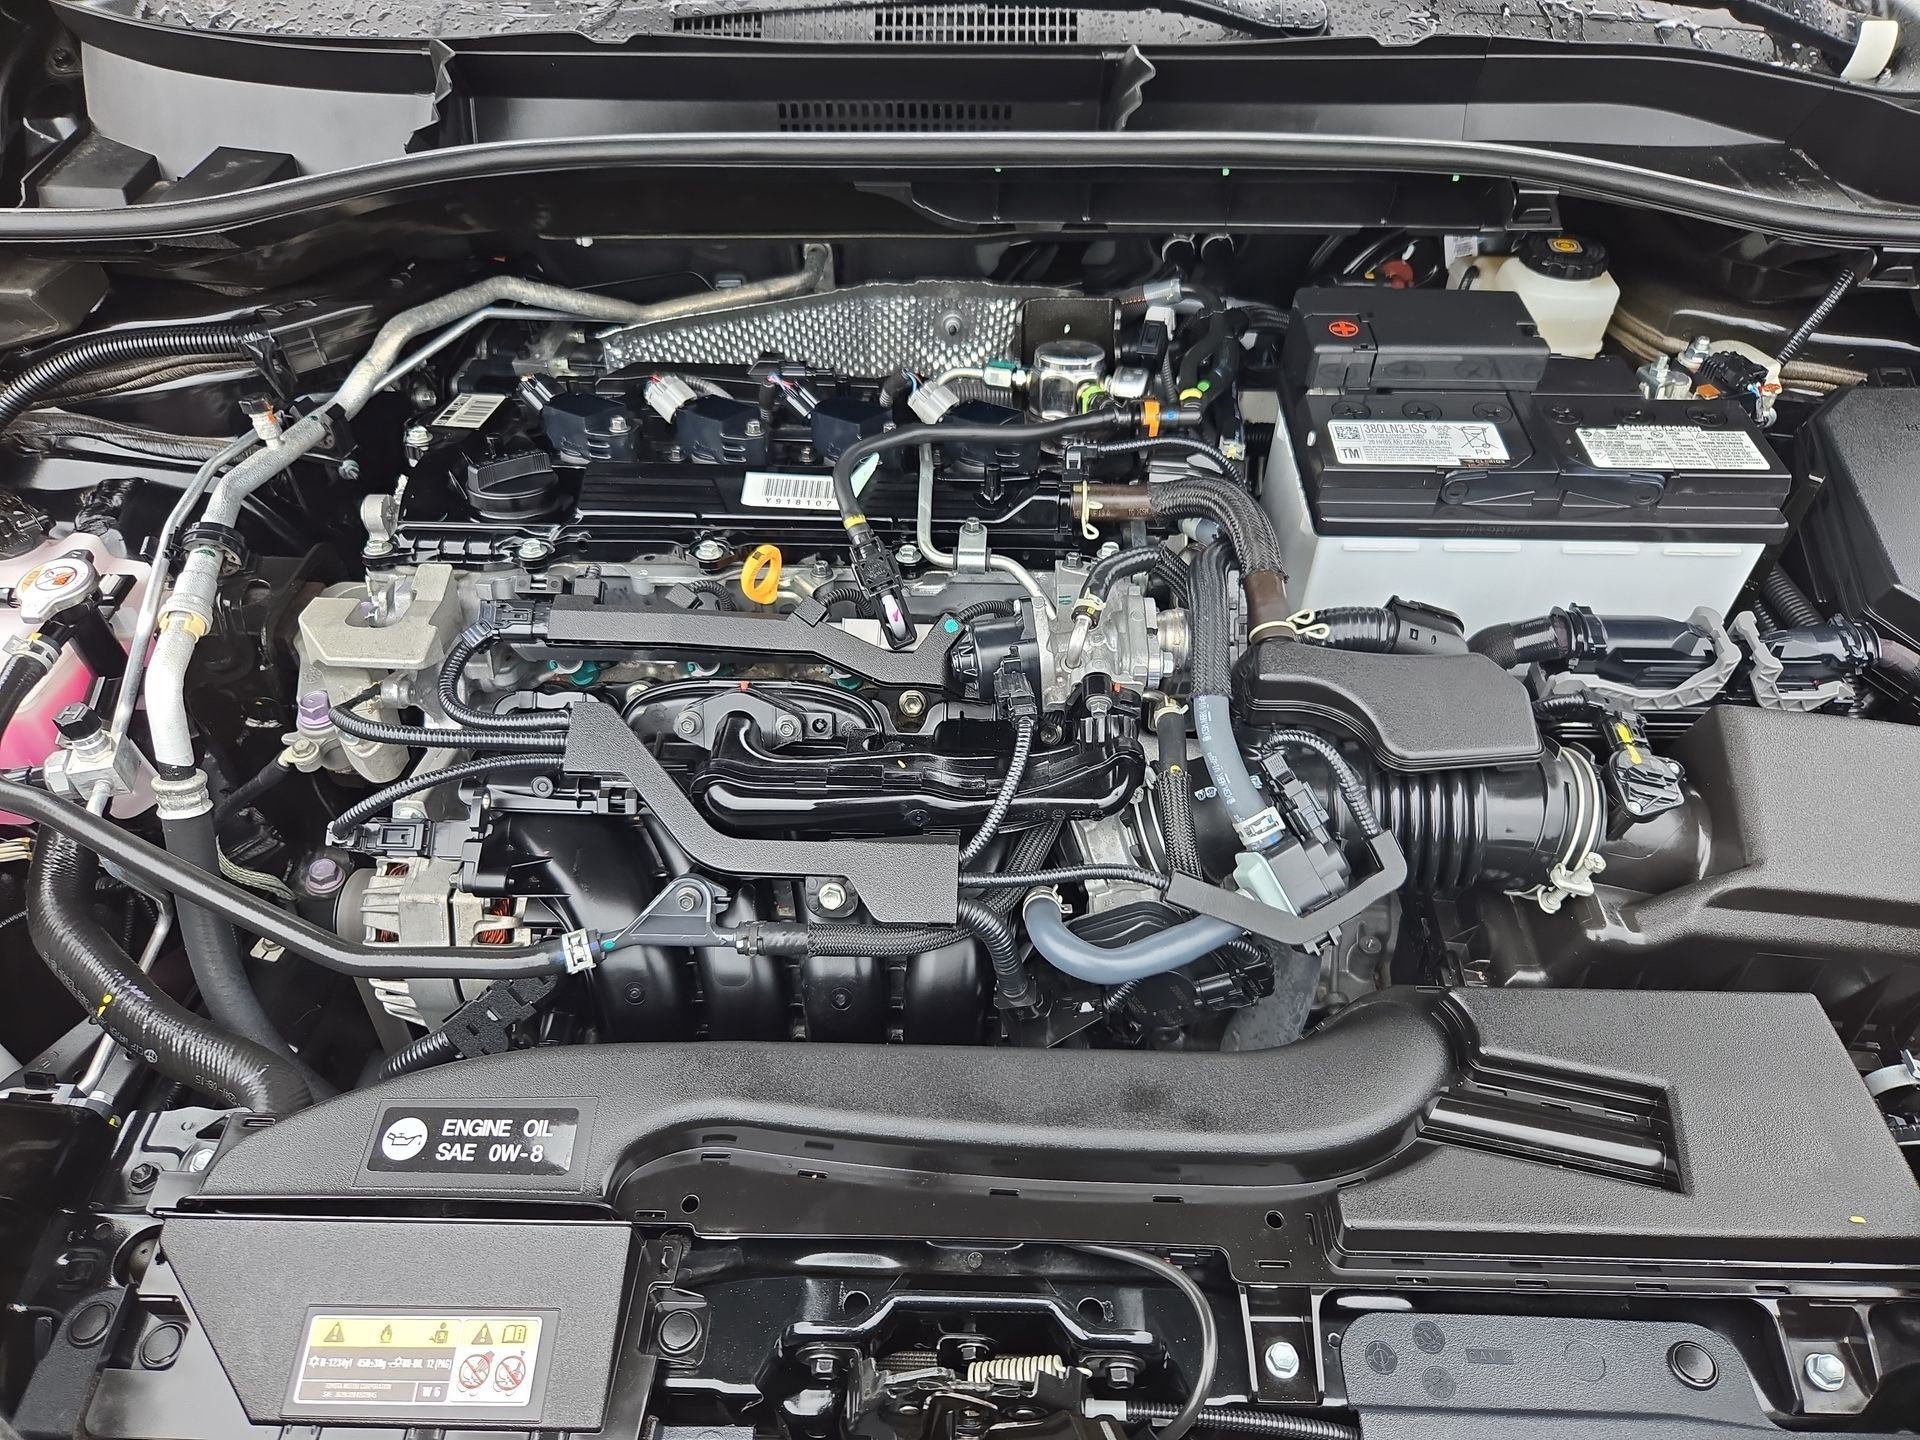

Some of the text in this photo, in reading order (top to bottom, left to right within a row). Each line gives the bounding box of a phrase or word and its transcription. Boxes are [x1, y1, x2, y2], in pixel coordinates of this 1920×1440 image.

[1364, 423, 1428, 434] 380LN3-ISS
[1343, 448, 1360, 459] TM
[765, 497, 832, 508] Y918107
[57, 705, 84, 720] H
[441, 1118, 554, 1138] ENGINE OIL
[435, 1142, 544, 1163] SAE 0W-8
[422, 1386, 442, 1398] W 6
